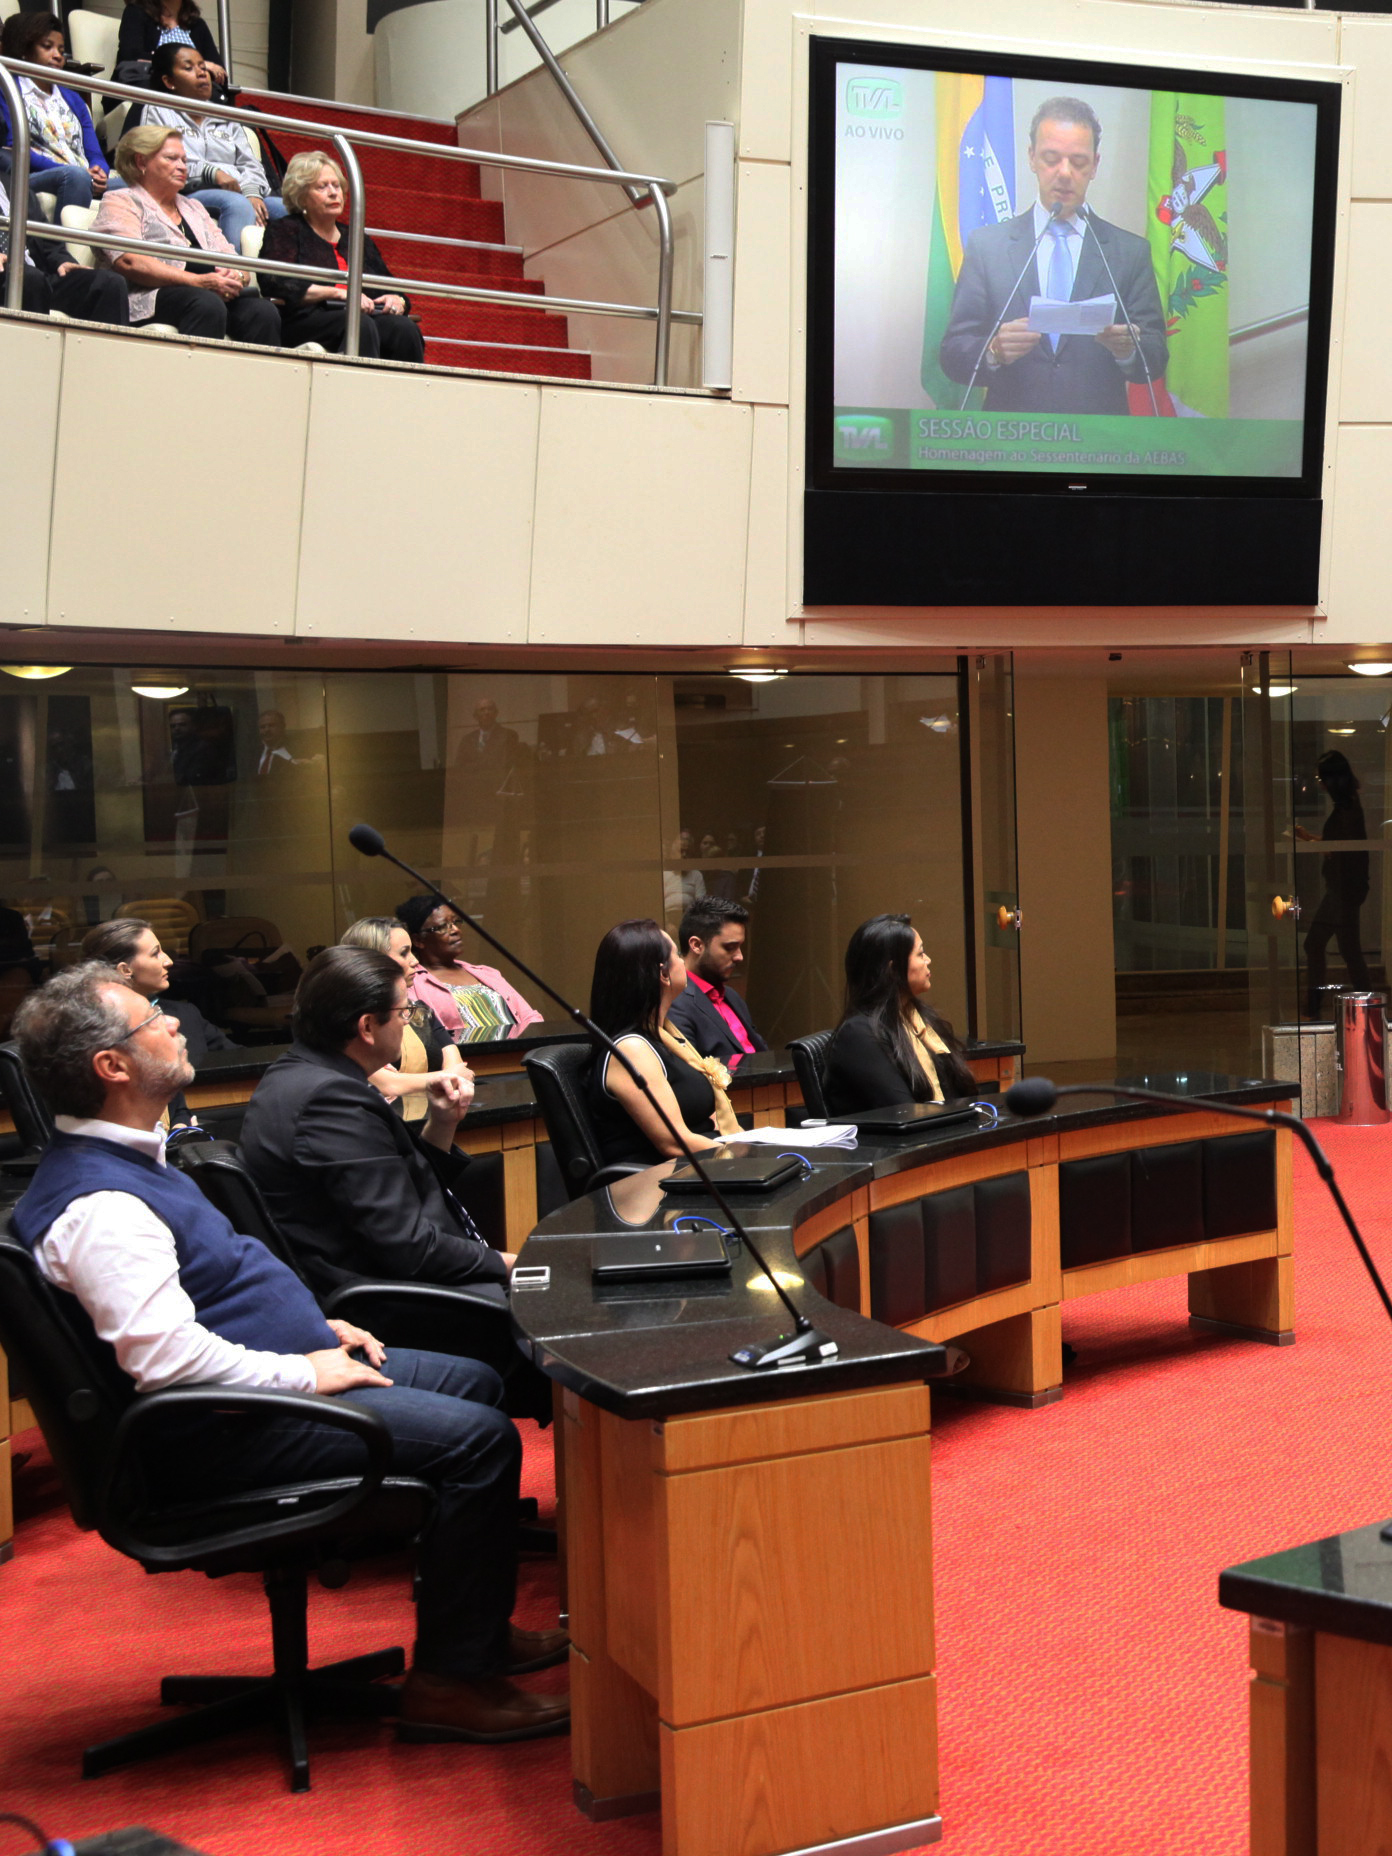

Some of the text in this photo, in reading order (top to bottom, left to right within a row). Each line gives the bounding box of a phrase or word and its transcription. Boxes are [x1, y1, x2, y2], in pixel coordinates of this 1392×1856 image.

[845, 125, 905, 141] AO VIVO
[918, 417, 1082, 442] SESSÃO ESPECIAL
[918, 447, 1008, 463] Homenagem
[1011, 451, 1026, 462] ao
[1124, 451, 1140, 464] da
[1143, 452, 1185, 466] AEBAS
